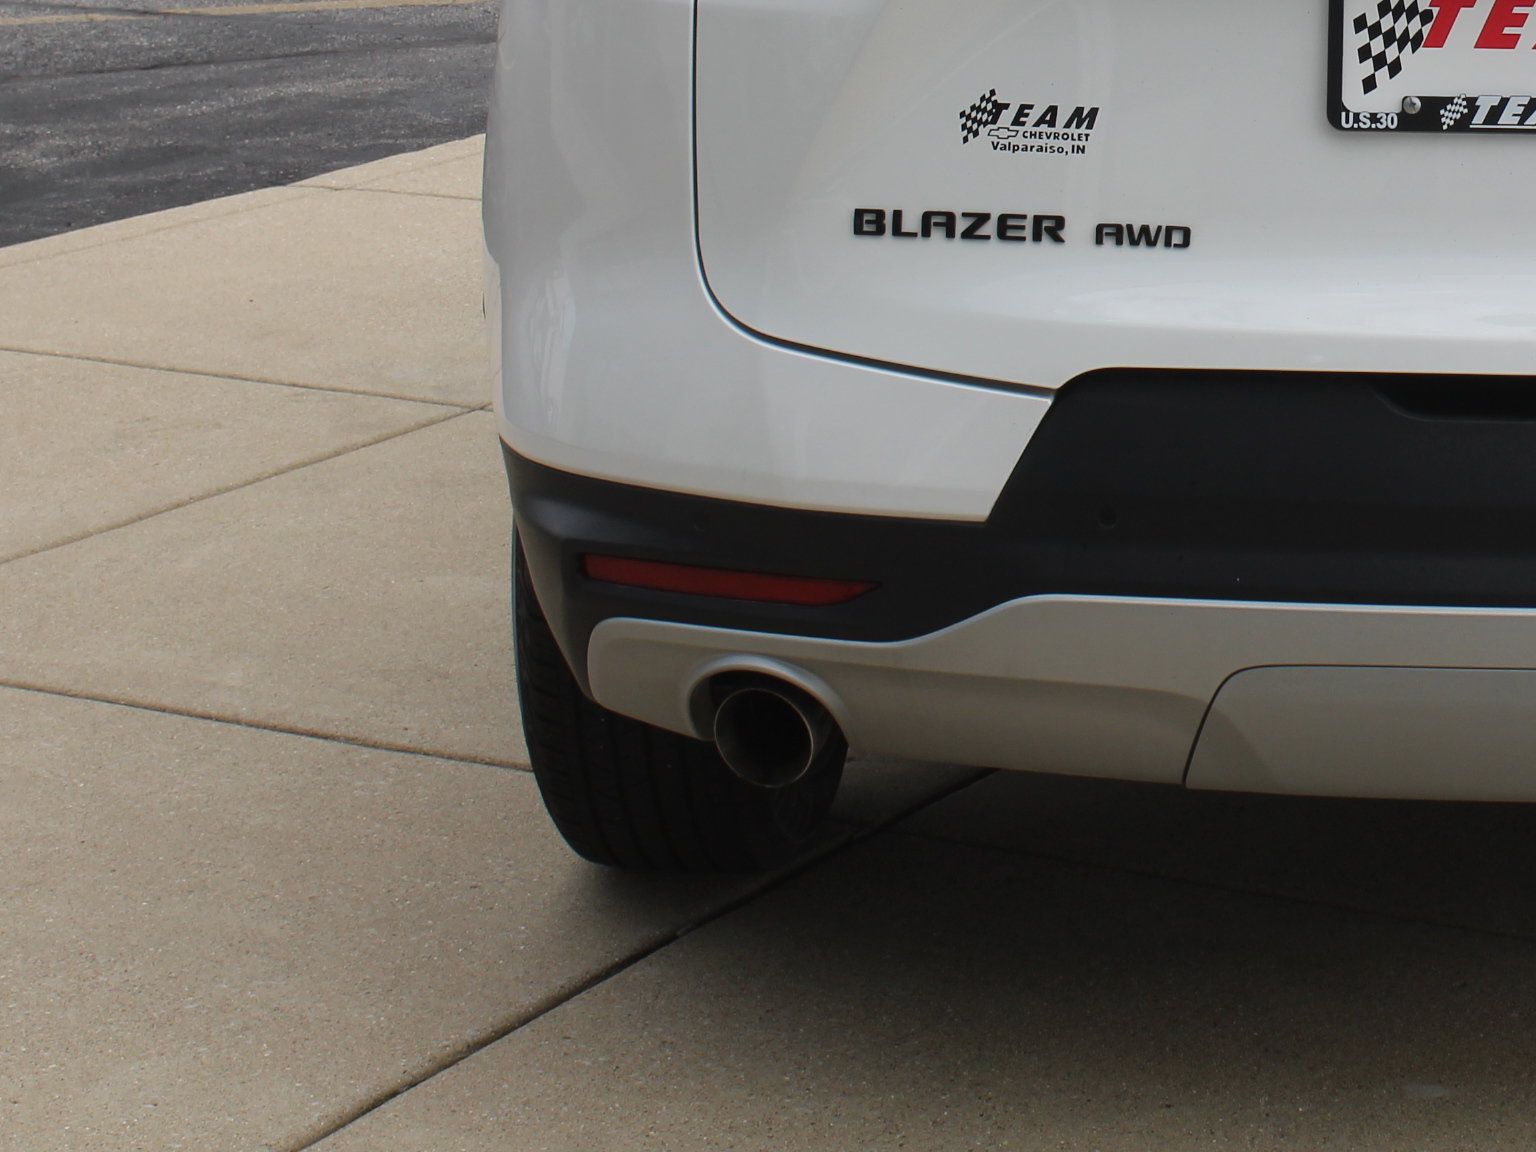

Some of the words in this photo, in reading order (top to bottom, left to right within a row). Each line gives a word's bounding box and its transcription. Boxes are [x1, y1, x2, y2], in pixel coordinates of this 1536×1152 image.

[988, 102, 1100, 130] TEAM
[1340, 111, 1398, 130] U.S.30
[1022, 130, 1090, 142] CHEVROLET
[991, 140, 1069, 156] Valparaiso,
[1071, 143, 1086, 154] IN
[853, 207, 1065, 243] BLAZER
[1095, 223, 1191, 249] AWD
